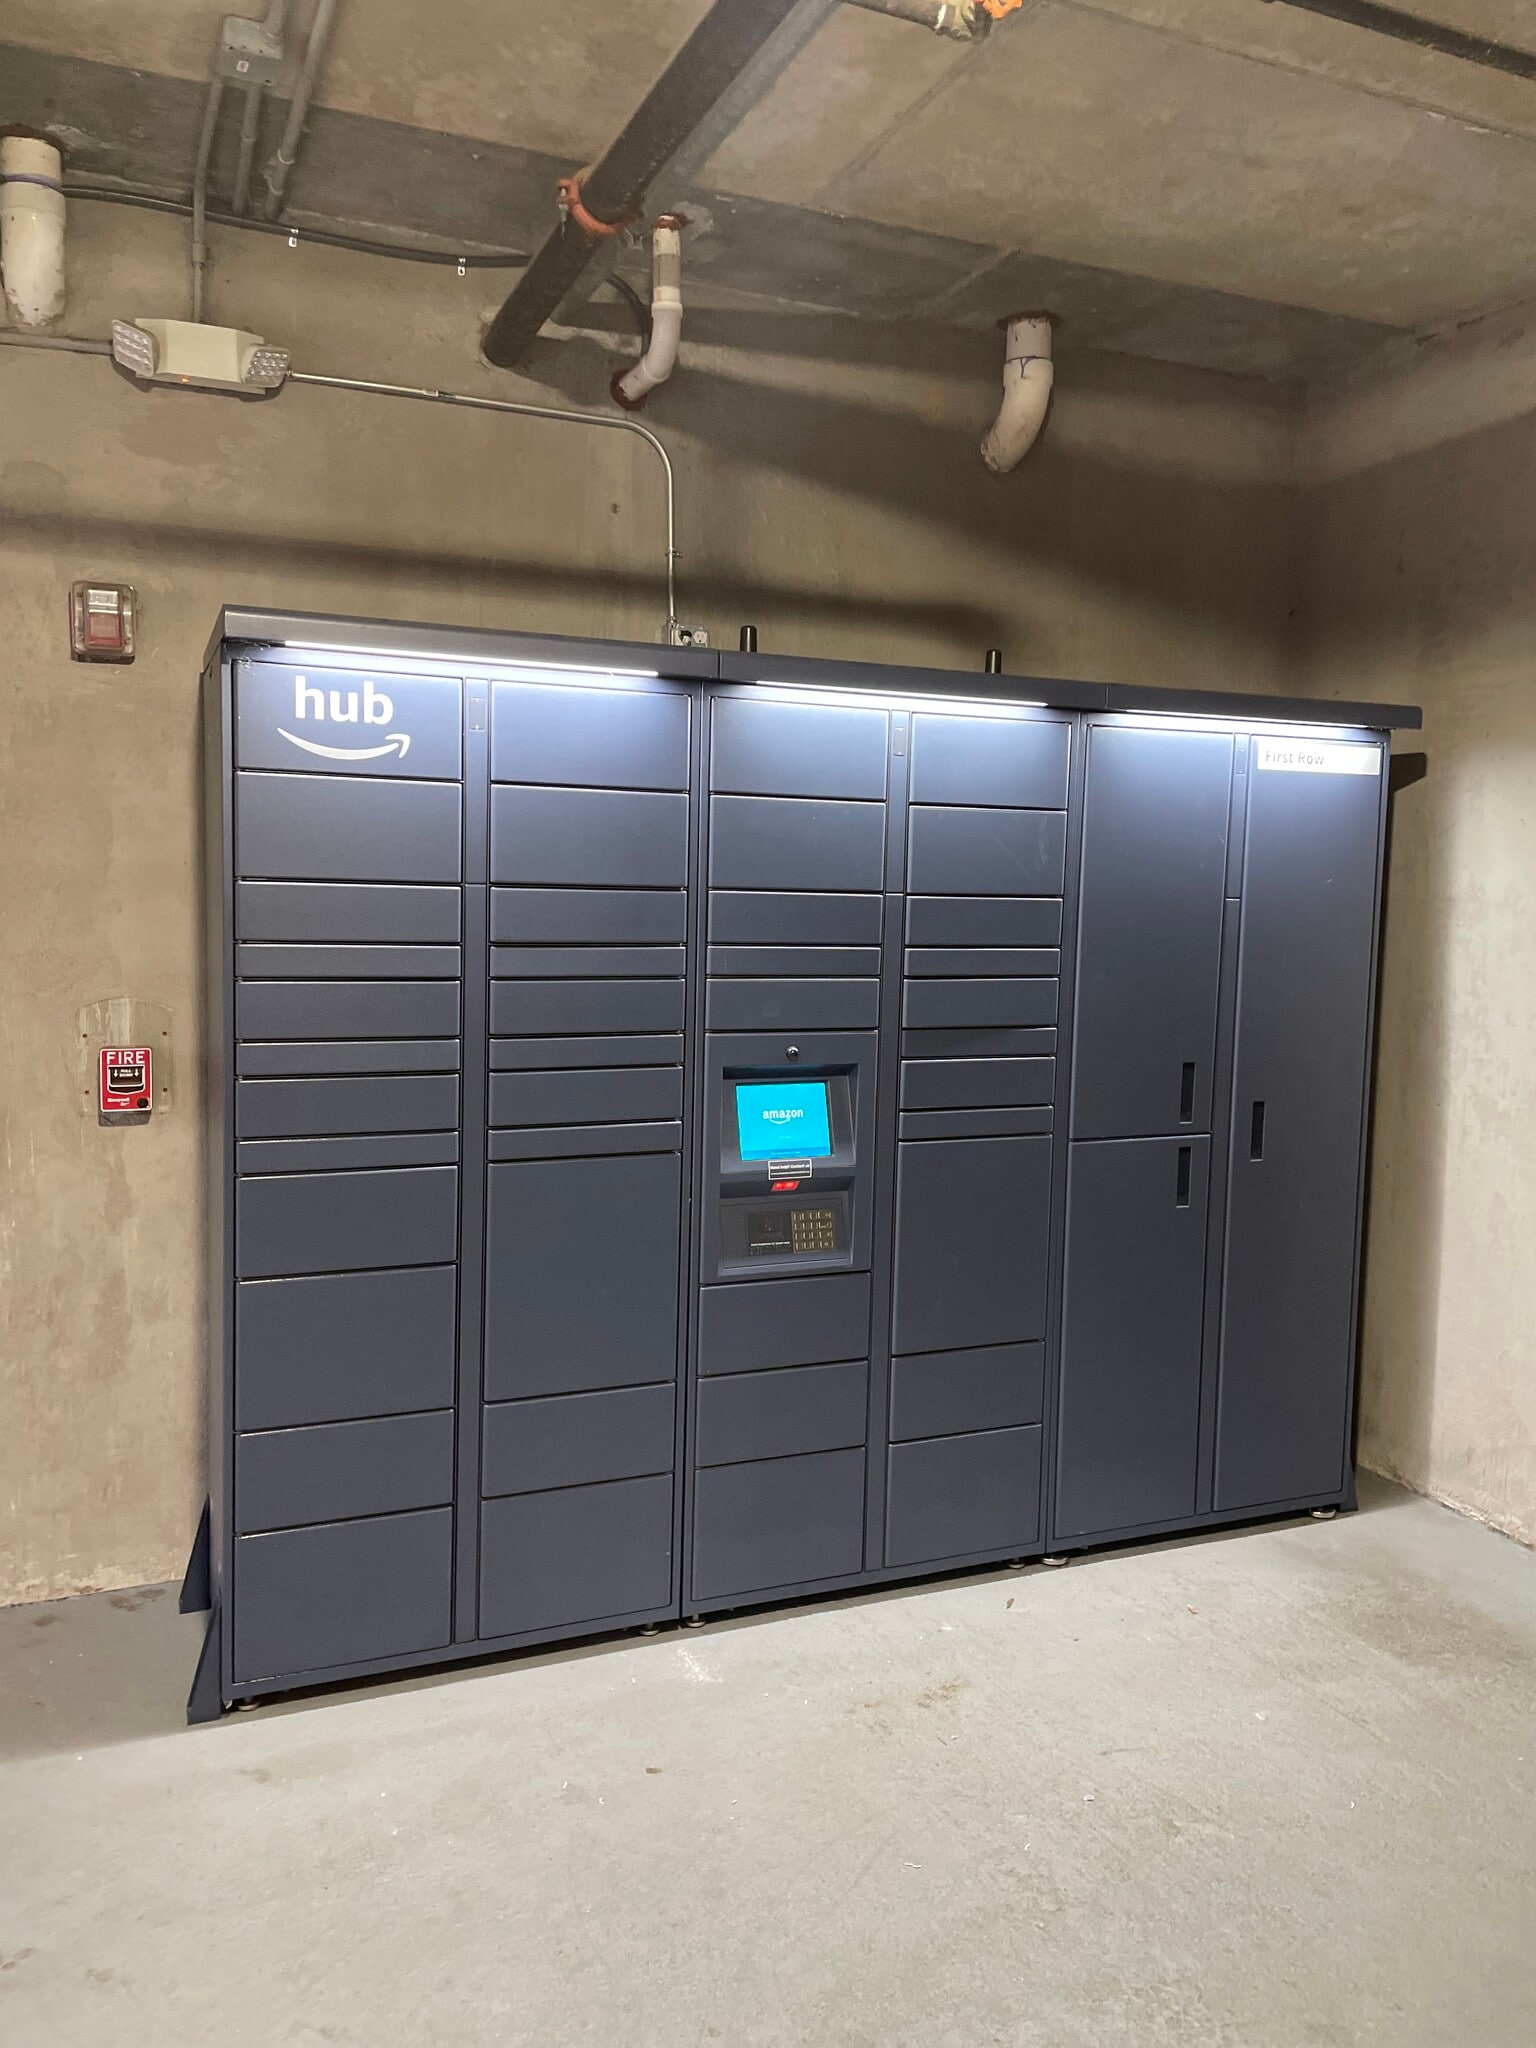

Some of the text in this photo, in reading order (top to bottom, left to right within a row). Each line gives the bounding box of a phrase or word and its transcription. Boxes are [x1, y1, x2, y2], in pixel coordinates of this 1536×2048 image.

[295, 675, 394, 725] hub
[1265, 750, 1324, 765] First Row
[106, 1051, 145, 1065] FIRE
[762, 1108, 804, 1119] amazon
